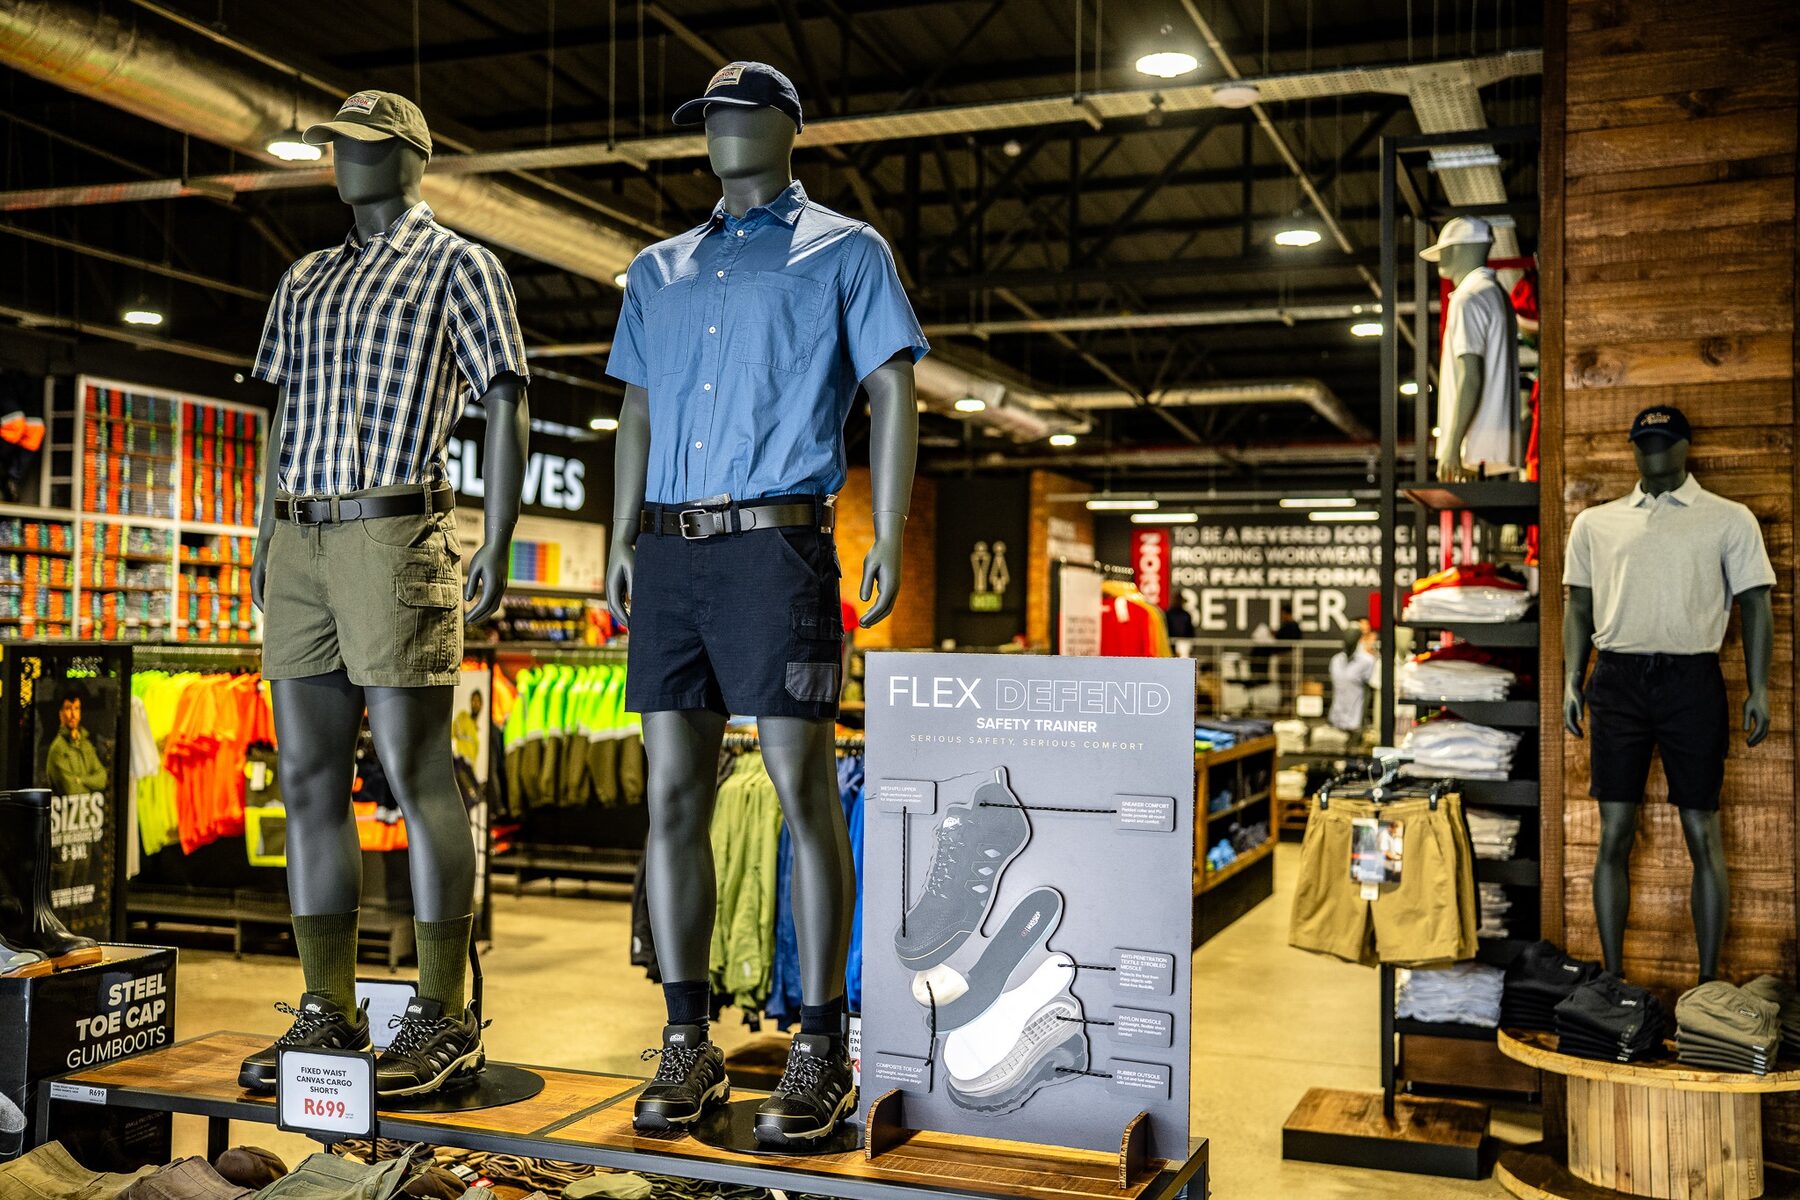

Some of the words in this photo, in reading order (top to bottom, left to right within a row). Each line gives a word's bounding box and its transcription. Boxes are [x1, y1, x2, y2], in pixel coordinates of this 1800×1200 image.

[447, 435, 586, 512] GLVES
[1171, 546, 1264, 565] PROVIDING
[1264, 545, 1371, 566] WORKWEAR
[1171, 566, 1208, 587] FOR
[1209, 566, 1265, 586] PEAK
[889, 675, 982, 709] FLEX
[995, 678, 1170, 715] DEFEND
[976, 717, 1031, 731] SAFETY
[1034, 719, 1097, 733] TRAINER
[910, 734, 962, 743] SERIOUS
[1022, 738, 1076, 748] SERIOUS
[1083, 740, 1144, 750] COMFORT
[51, 791, 105, 833] SIZES
[108, 973, 167, 1006] STEEL
[76, 1010, 121, 1041] TOE
[125, 999, 166, 1029] CAP
[66, 1025, 166, 1069] GUMBOOTS
[300, 1066, 321, 1075] FIXED
[322, 1069, 347, 1077] WAIST
[875, 1062, 902, 1071] COMPOSITE
[296, 1075, 325, 1085] CANVAS
[326, 1079, 353, 1087] CARGO
[310, 1086, 339, 1095] SHORTS
[89, 1088, 105, 1098] R699
[304, 1097, 346, 1118] R699
